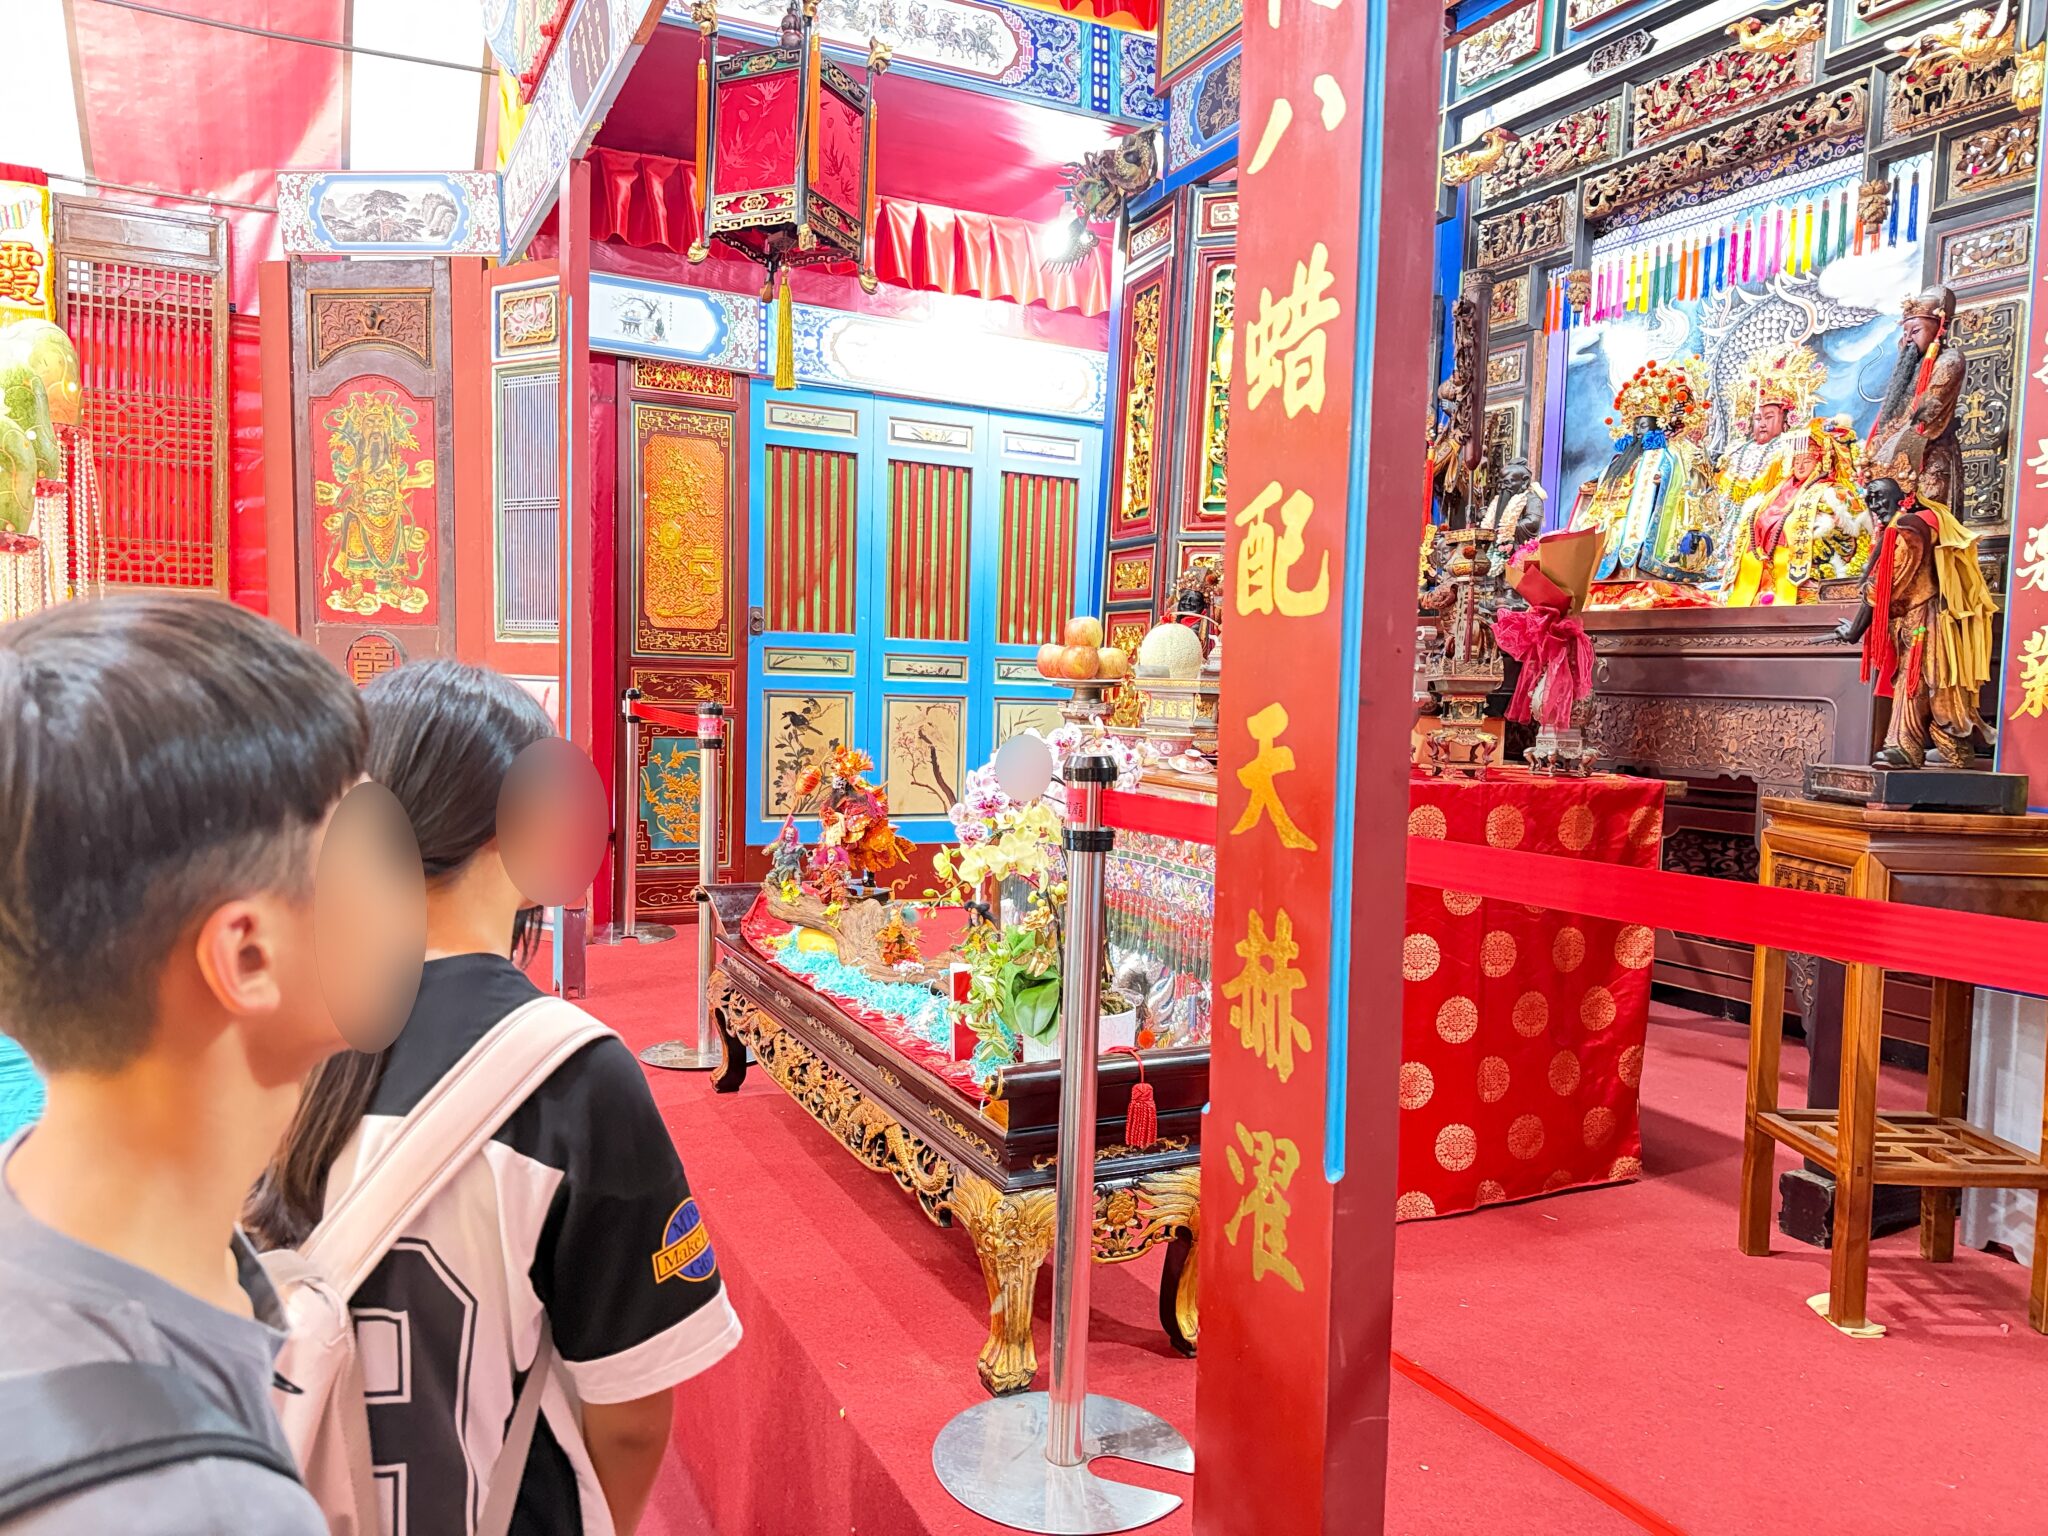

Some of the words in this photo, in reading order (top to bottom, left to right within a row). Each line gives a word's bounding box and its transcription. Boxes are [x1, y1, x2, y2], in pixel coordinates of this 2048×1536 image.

[1220, 0, 1346, 1292] 八蜡配天赫濯
